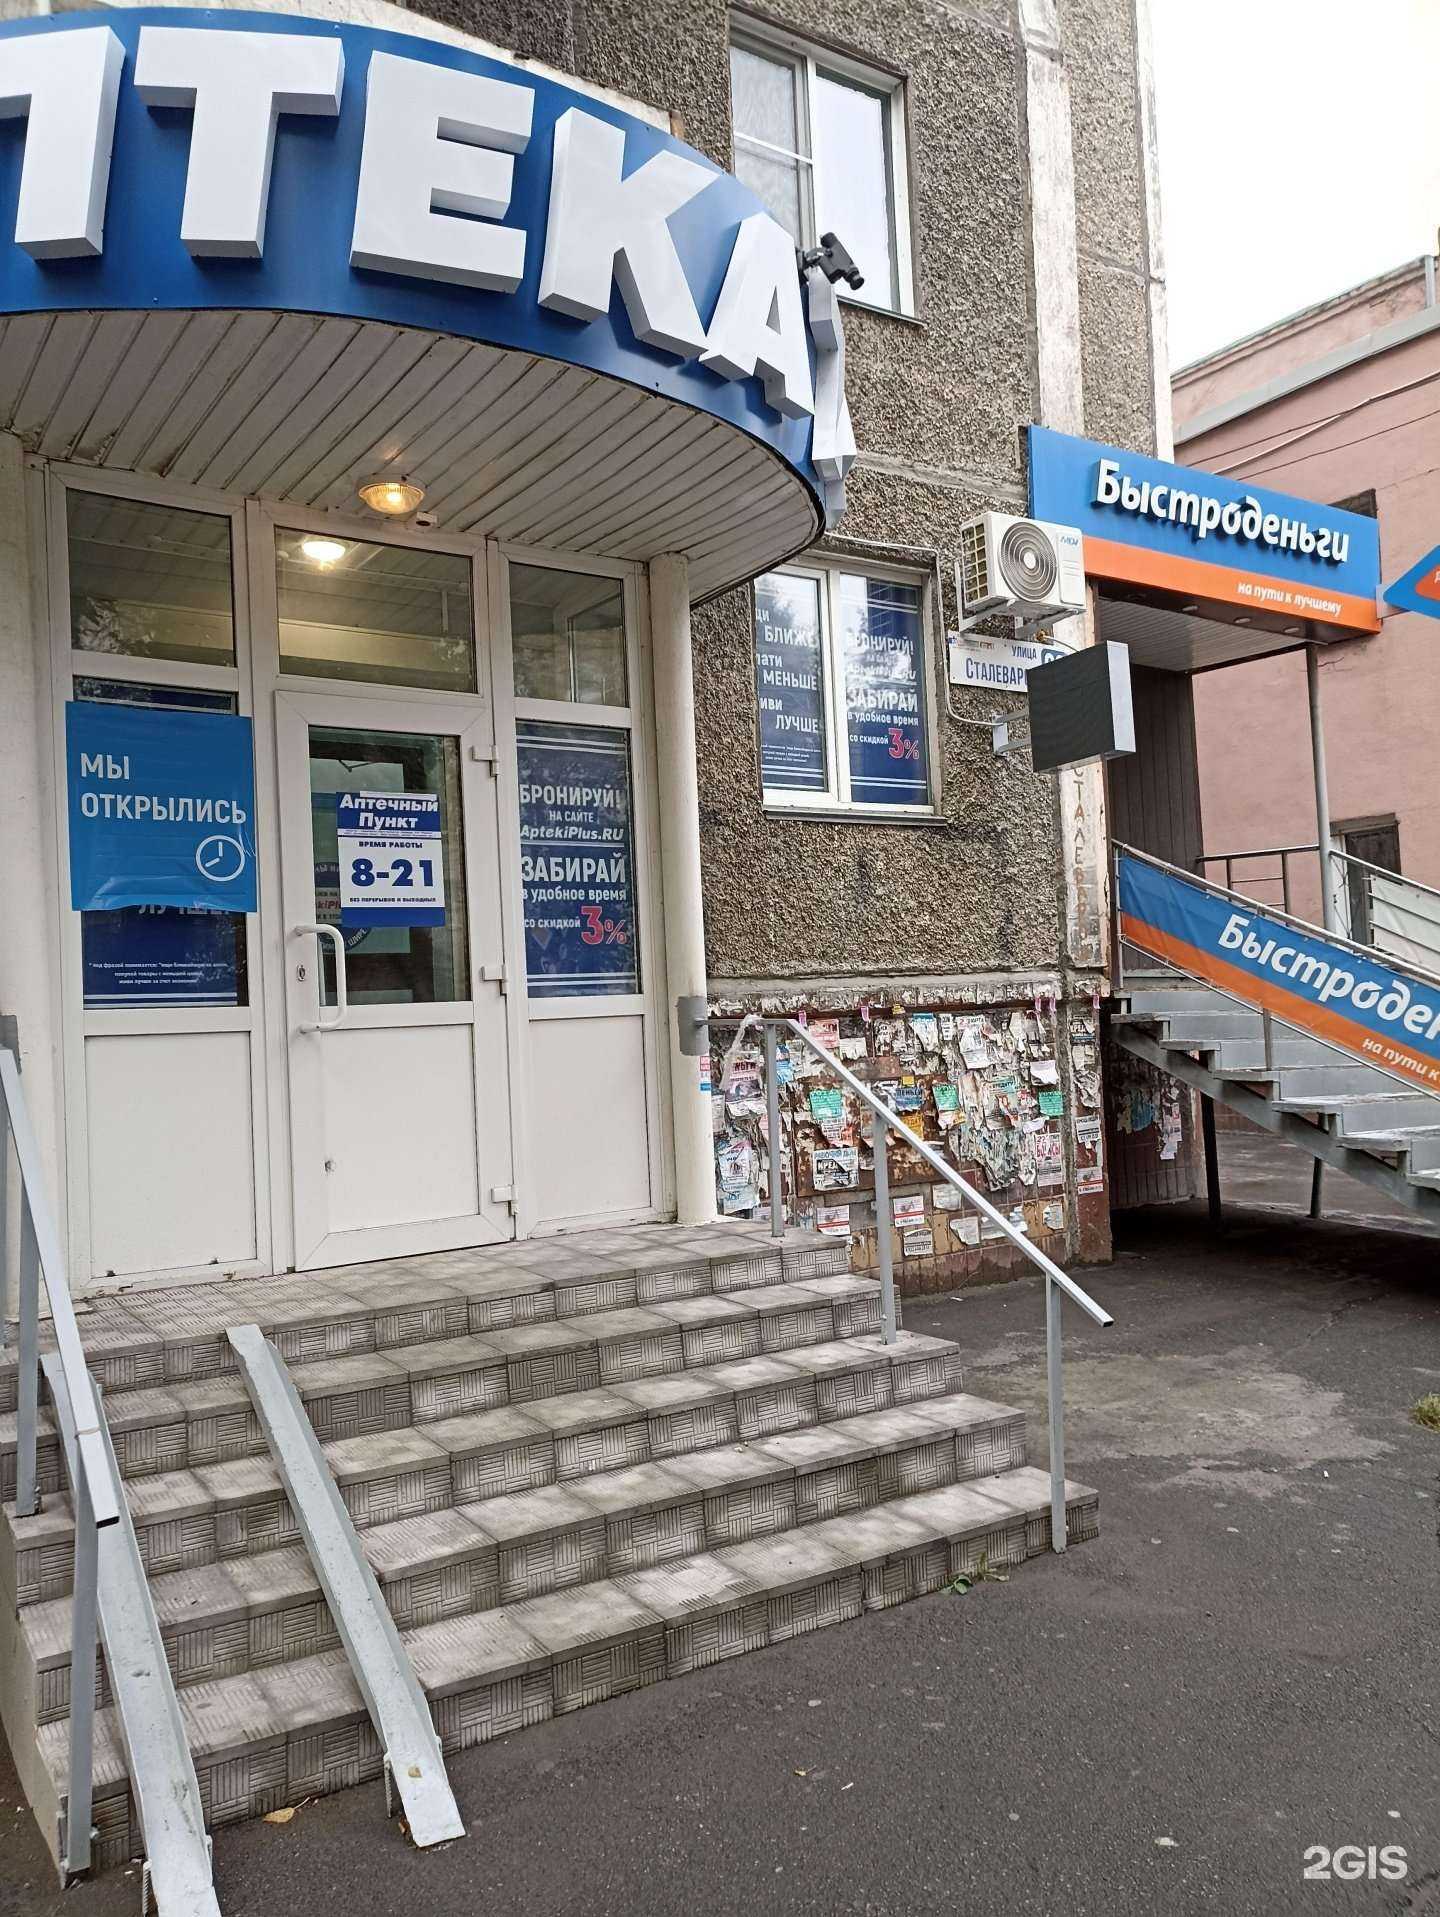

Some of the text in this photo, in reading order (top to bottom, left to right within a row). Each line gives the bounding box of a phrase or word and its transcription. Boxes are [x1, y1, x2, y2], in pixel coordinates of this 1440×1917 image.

[1096, 458, 1350, 563] Быстроденьги
[1237, 582, 1342, 617] на пути к лучшему
[764, 625, 818, 648] БЛИЖЕ
[1011, 645, 1037, 660] УЛИЦА
[763, 669, 818, 691] МЕНЬШЕ
[965, 657, 1028, 686] СТАЛЕВАР
[847, 688, 918, 713] ЗАБИРАЙ
[775, 714, 819, 734] ЛУЧШЕ
[854, 712, 891, 726] удобное
[893, 714, 919, 727] время
[849, 734, 889, 745] со скидкой
[81, 752, 130, 781] МЫ
[340, 794, 439, 812] Аптечный
[520, 784, 621, 808] БРОНИРУЙ!
[81, 792, 247, 824] ОТКРЫЛИСЬ
[549, 809, 594, 824] НА САЙТЕ
[359, 812, 419, 830] Пункт
[520, 824, 624, 842] AptekiPlus.RU
[351, 858, 434, 887] 8-21
[521, 851, 627, 884] ЗАБИРАЙ
[531, 887, 585, 903] удобное
[588, 888, 627, 904] время
[524, 916, 581, 929] со скидкой
[581, 905, 627, 945] 3%
[1362, 1038, 1440, 1081] на пути к
